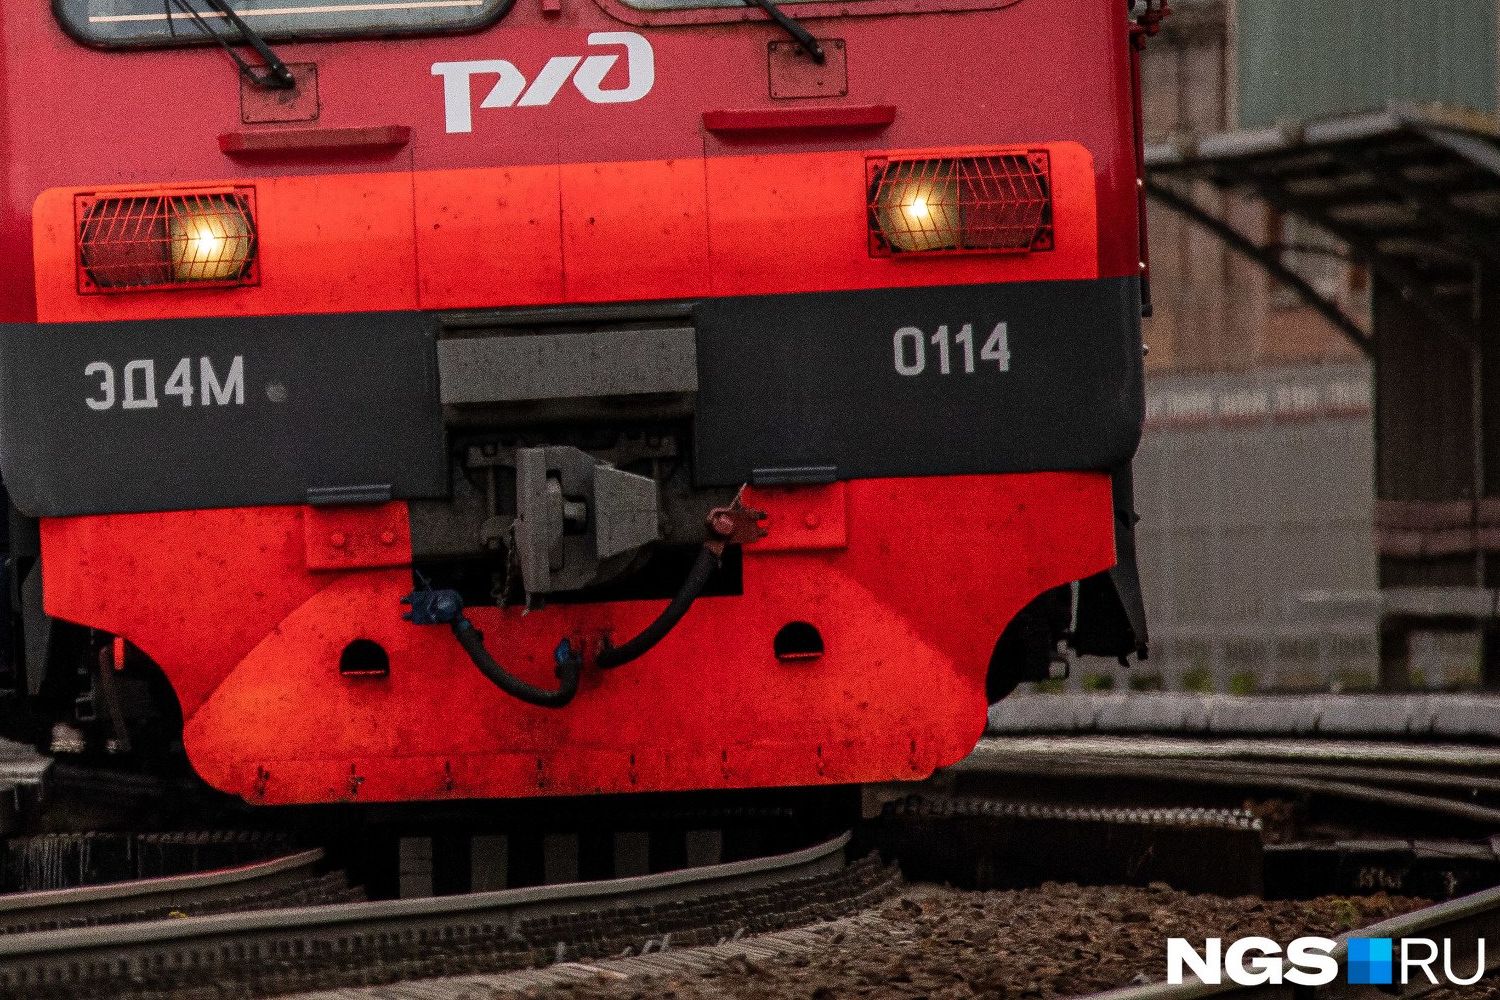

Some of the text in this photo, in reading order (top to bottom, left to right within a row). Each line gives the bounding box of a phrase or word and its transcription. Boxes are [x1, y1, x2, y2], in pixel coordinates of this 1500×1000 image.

[431, 32, 654, 133] РЖД
[893, 322, 1010, 376] 0114
[85, 356, 244, 410] ЭД4М
